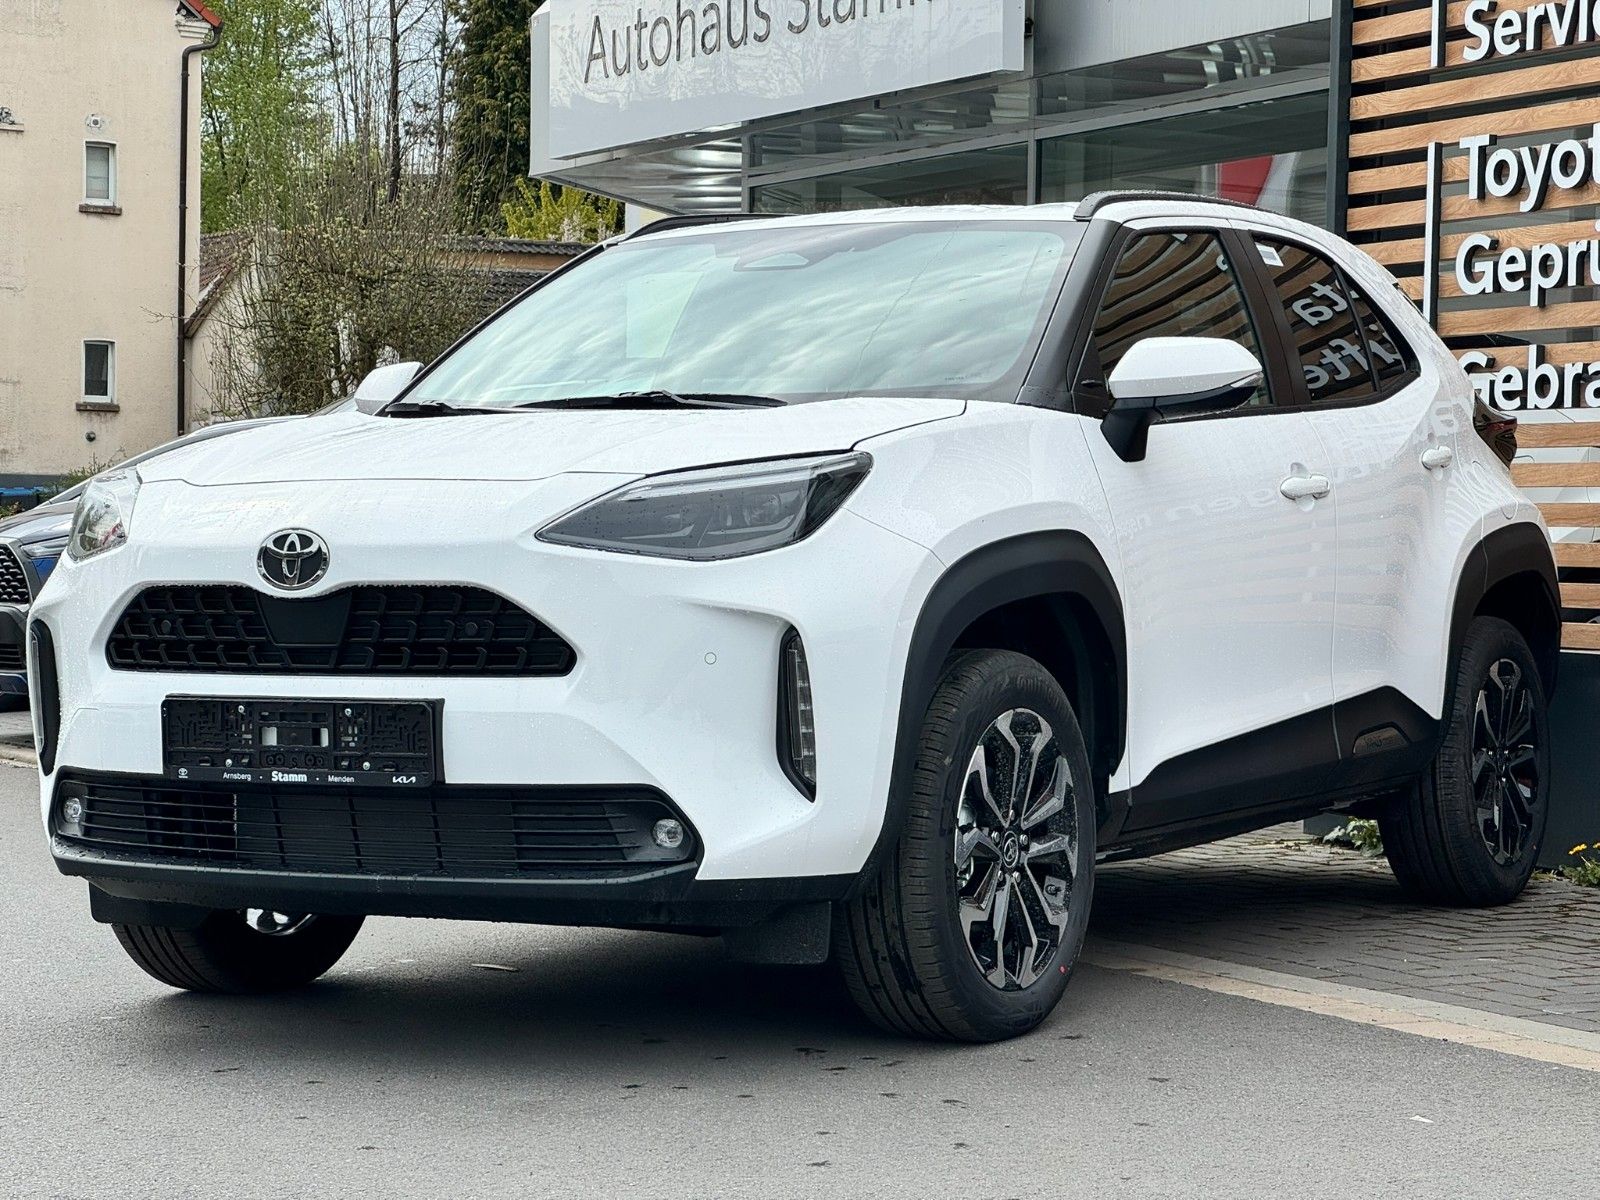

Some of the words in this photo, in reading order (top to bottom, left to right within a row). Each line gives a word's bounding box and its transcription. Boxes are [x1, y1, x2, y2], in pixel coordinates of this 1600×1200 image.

[584, 0, 771, 84] Autohaus
[1463, 0, 1600, 62] Servi
[222, 771, 252, 782] Arnsberg
[271, 770, 308, 782] Stamm
[327, 774, 355, 783] Menden
